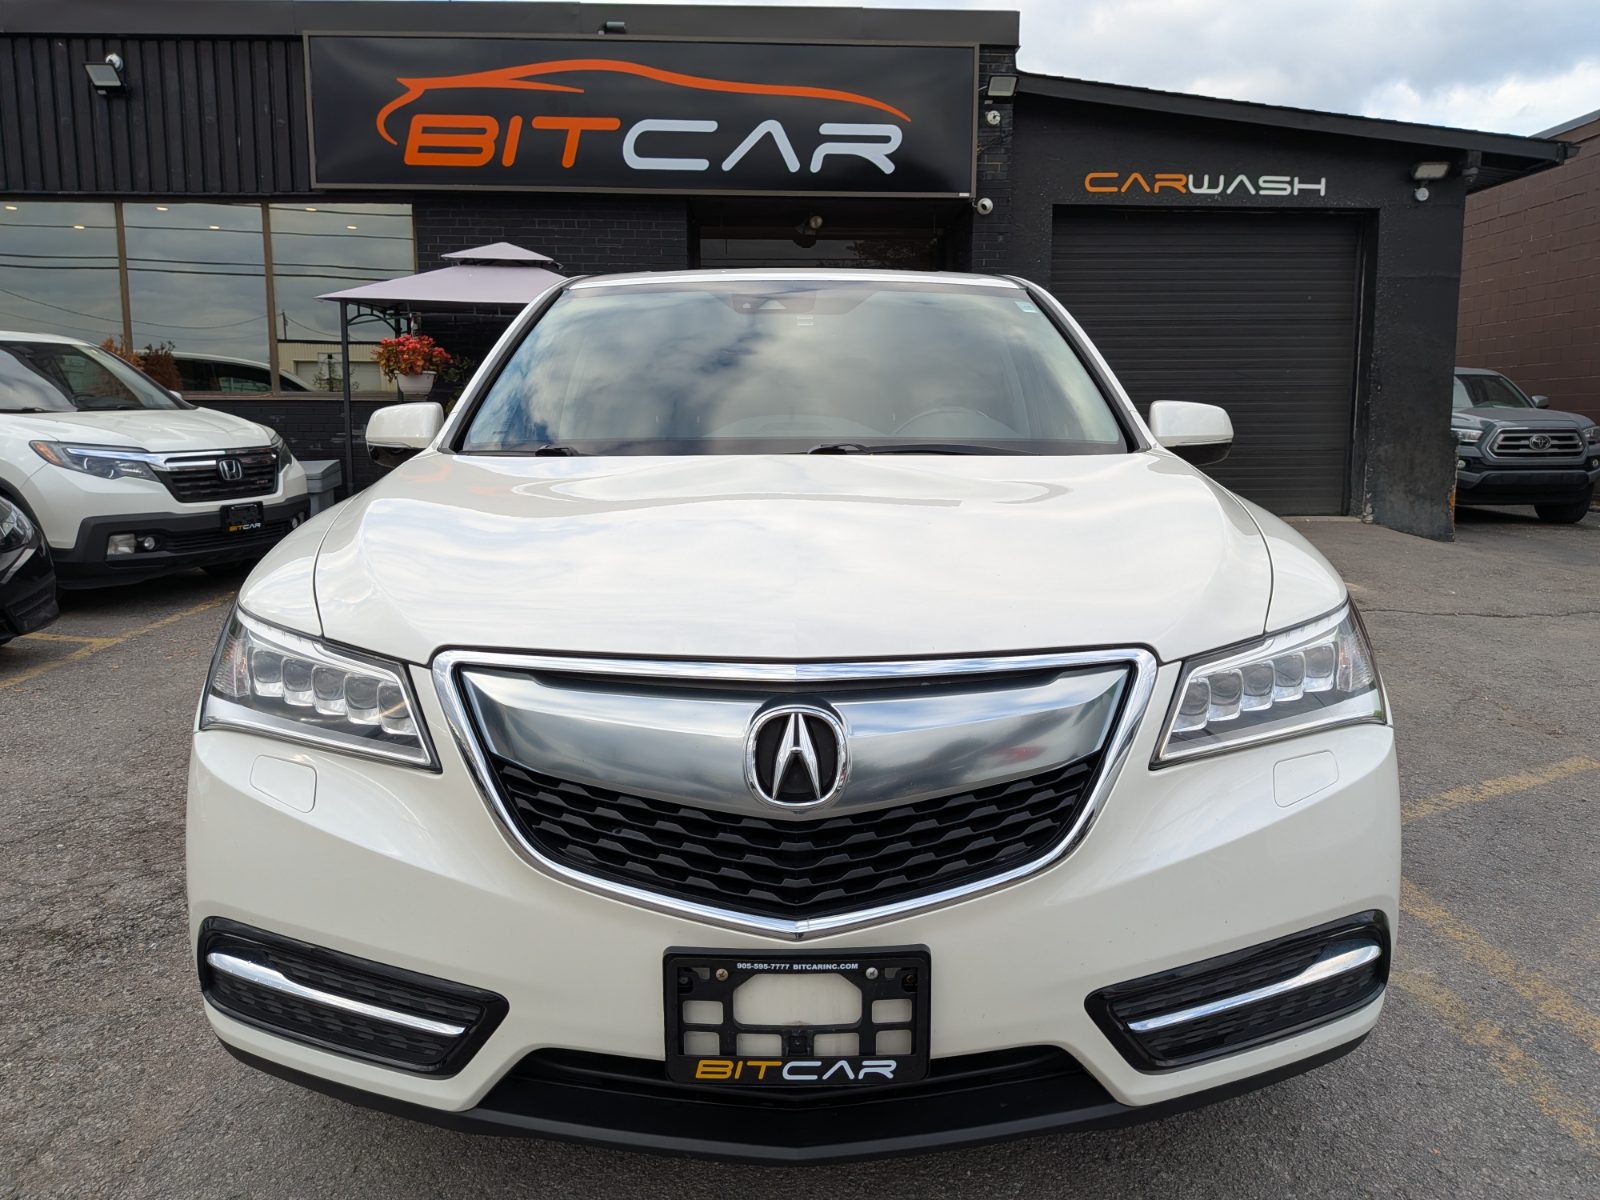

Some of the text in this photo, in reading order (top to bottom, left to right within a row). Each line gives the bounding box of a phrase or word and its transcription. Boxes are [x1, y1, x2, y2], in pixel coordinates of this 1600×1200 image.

[403, 113, 904, 175] BITCAR
[1084, 172, 1327, 198] CARWASH
[736, 962, 859, 971] 905-595-7777 BITCARINC.COM
[695, 1059, 897, 1081] BITCAR
